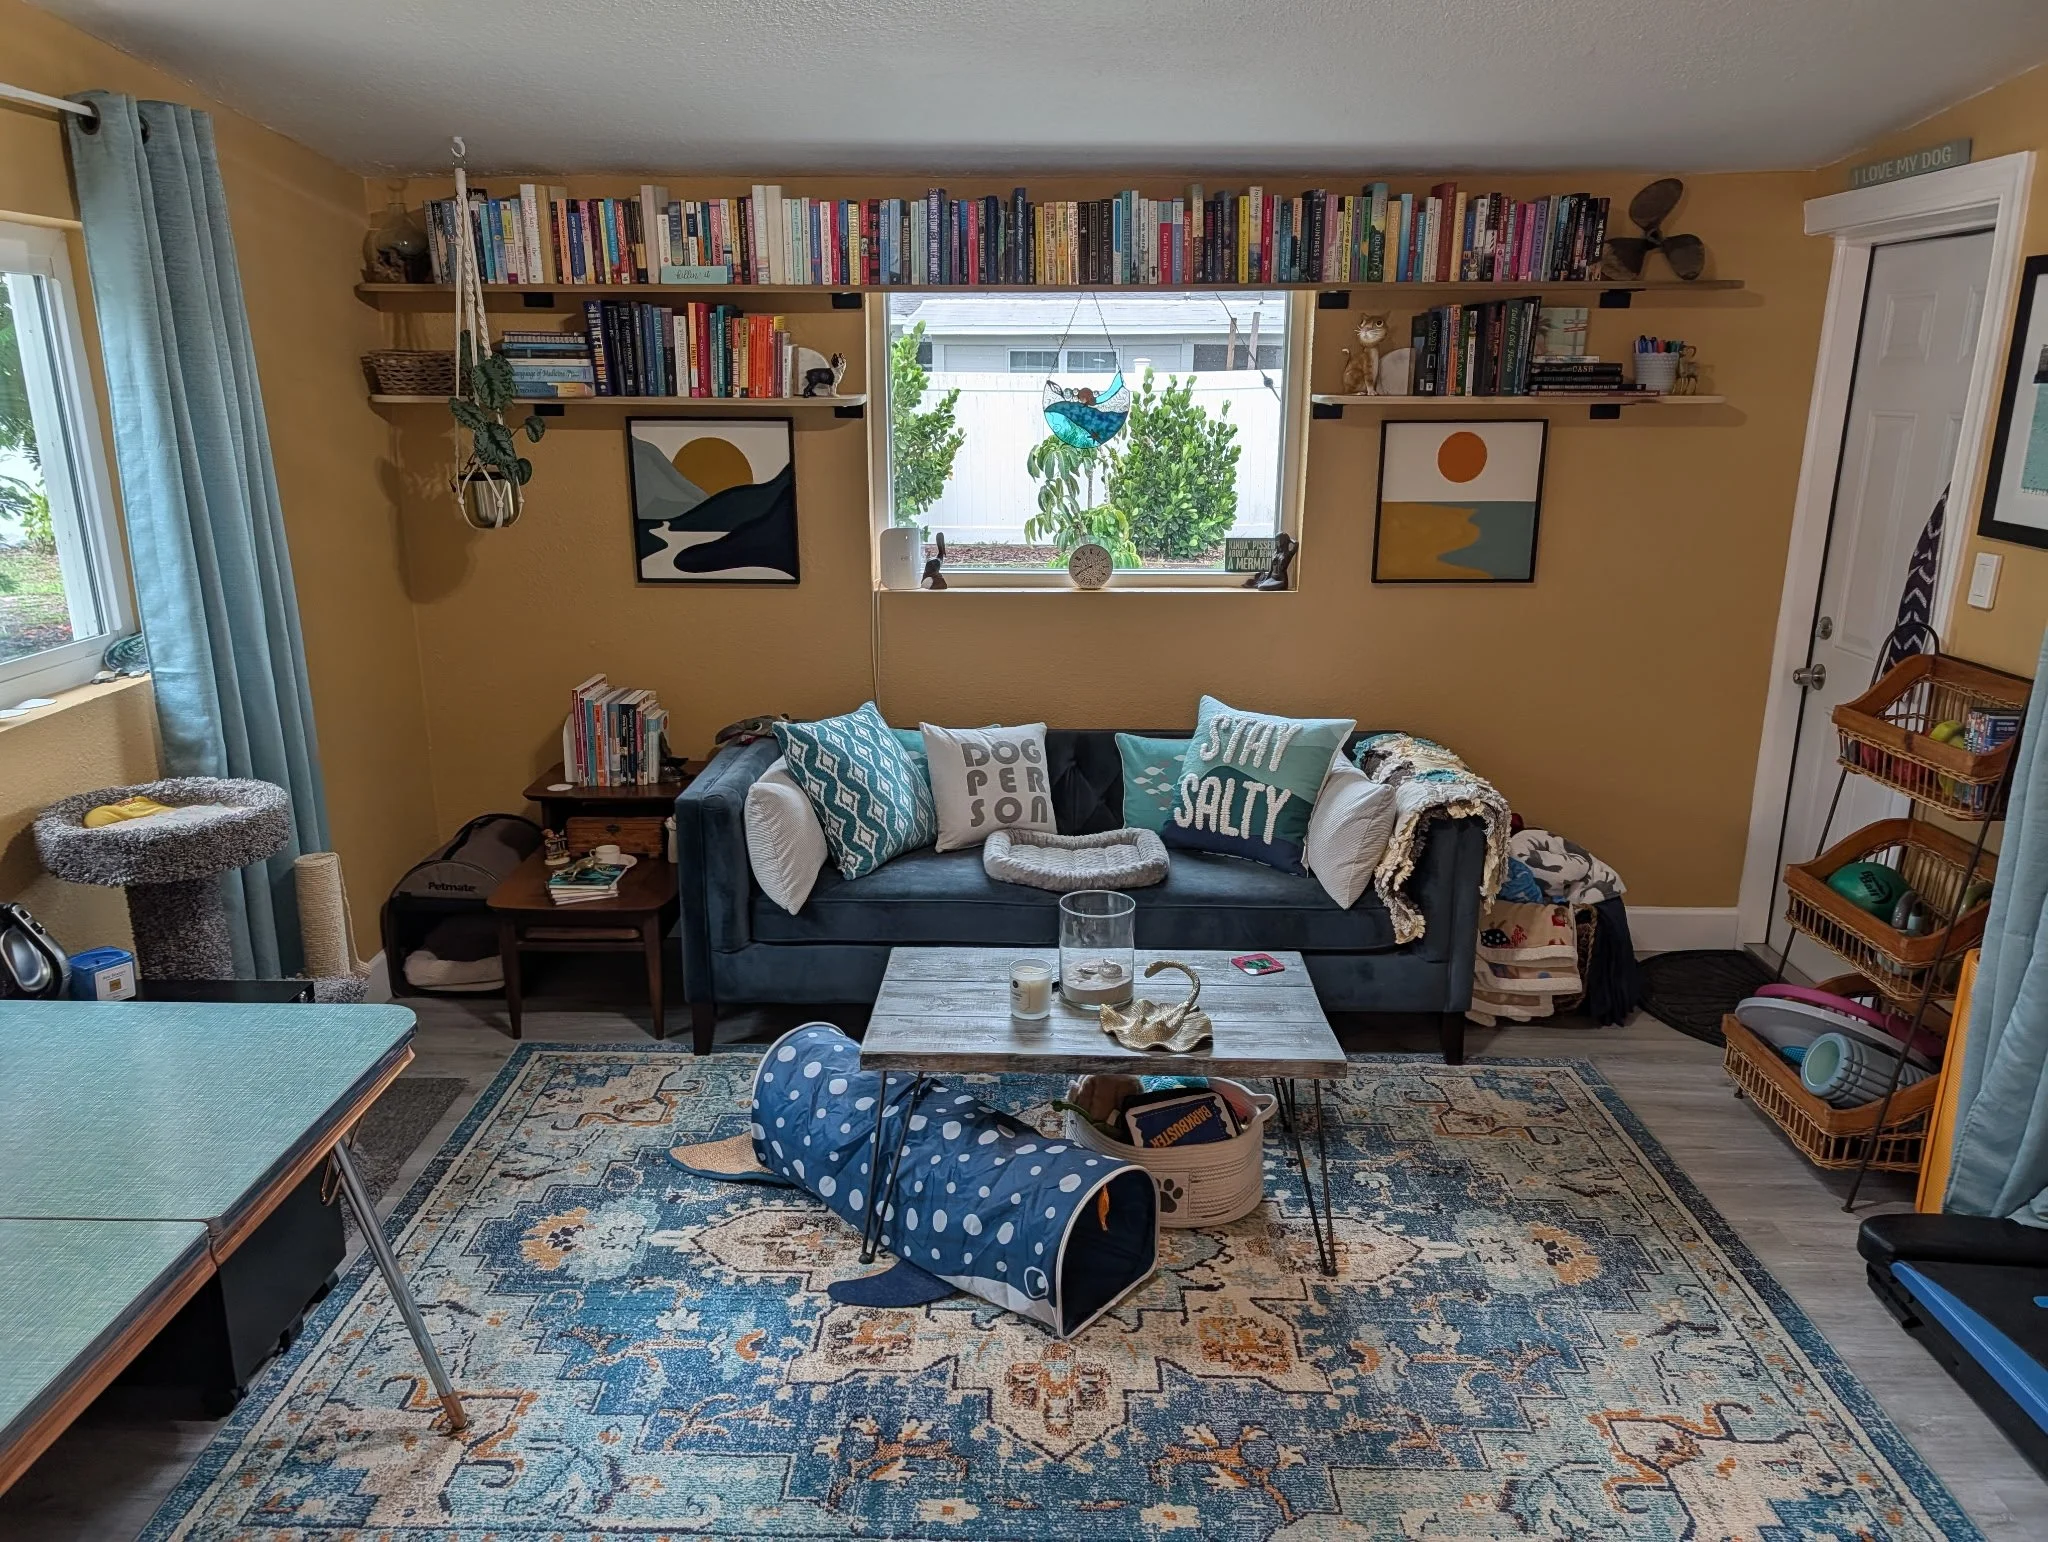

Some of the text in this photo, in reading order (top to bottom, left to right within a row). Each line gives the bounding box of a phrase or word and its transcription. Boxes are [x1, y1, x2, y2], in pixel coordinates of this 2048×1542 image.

[1863, 161, 1893, 183] LOVE
[1896, 154, 1917, 174] MY
[1922, 146, 1952, 168] DOG
[1538, 204, 1546, 222] ONE
[930, 194, 938, 274] FUNNY STORY EMILY HENRY
[1537, 226, 1543, 236] BY
[592, 327, 602, 340] THE
[1430, 320, 1438, 352] GHOSTS
[1456, 349, 1464, 379] IRELAND
[1506, 350, 1516, 372] Florida
[596, 366, 608, 382] BODY
[1229, 550, 1246, 558] ABOUT
[1247, 550, 1258, 558] NOT
[1253, 540, 1276, 550] PISSED
[961, 739, 1041, 767] DOG
[1200, 714, 1303, 772] STAY
[967, 767, 1046, 796] PER
[1174, 773, 1291, 845] SALTY
[428, 882, 476, 892] Petmate
